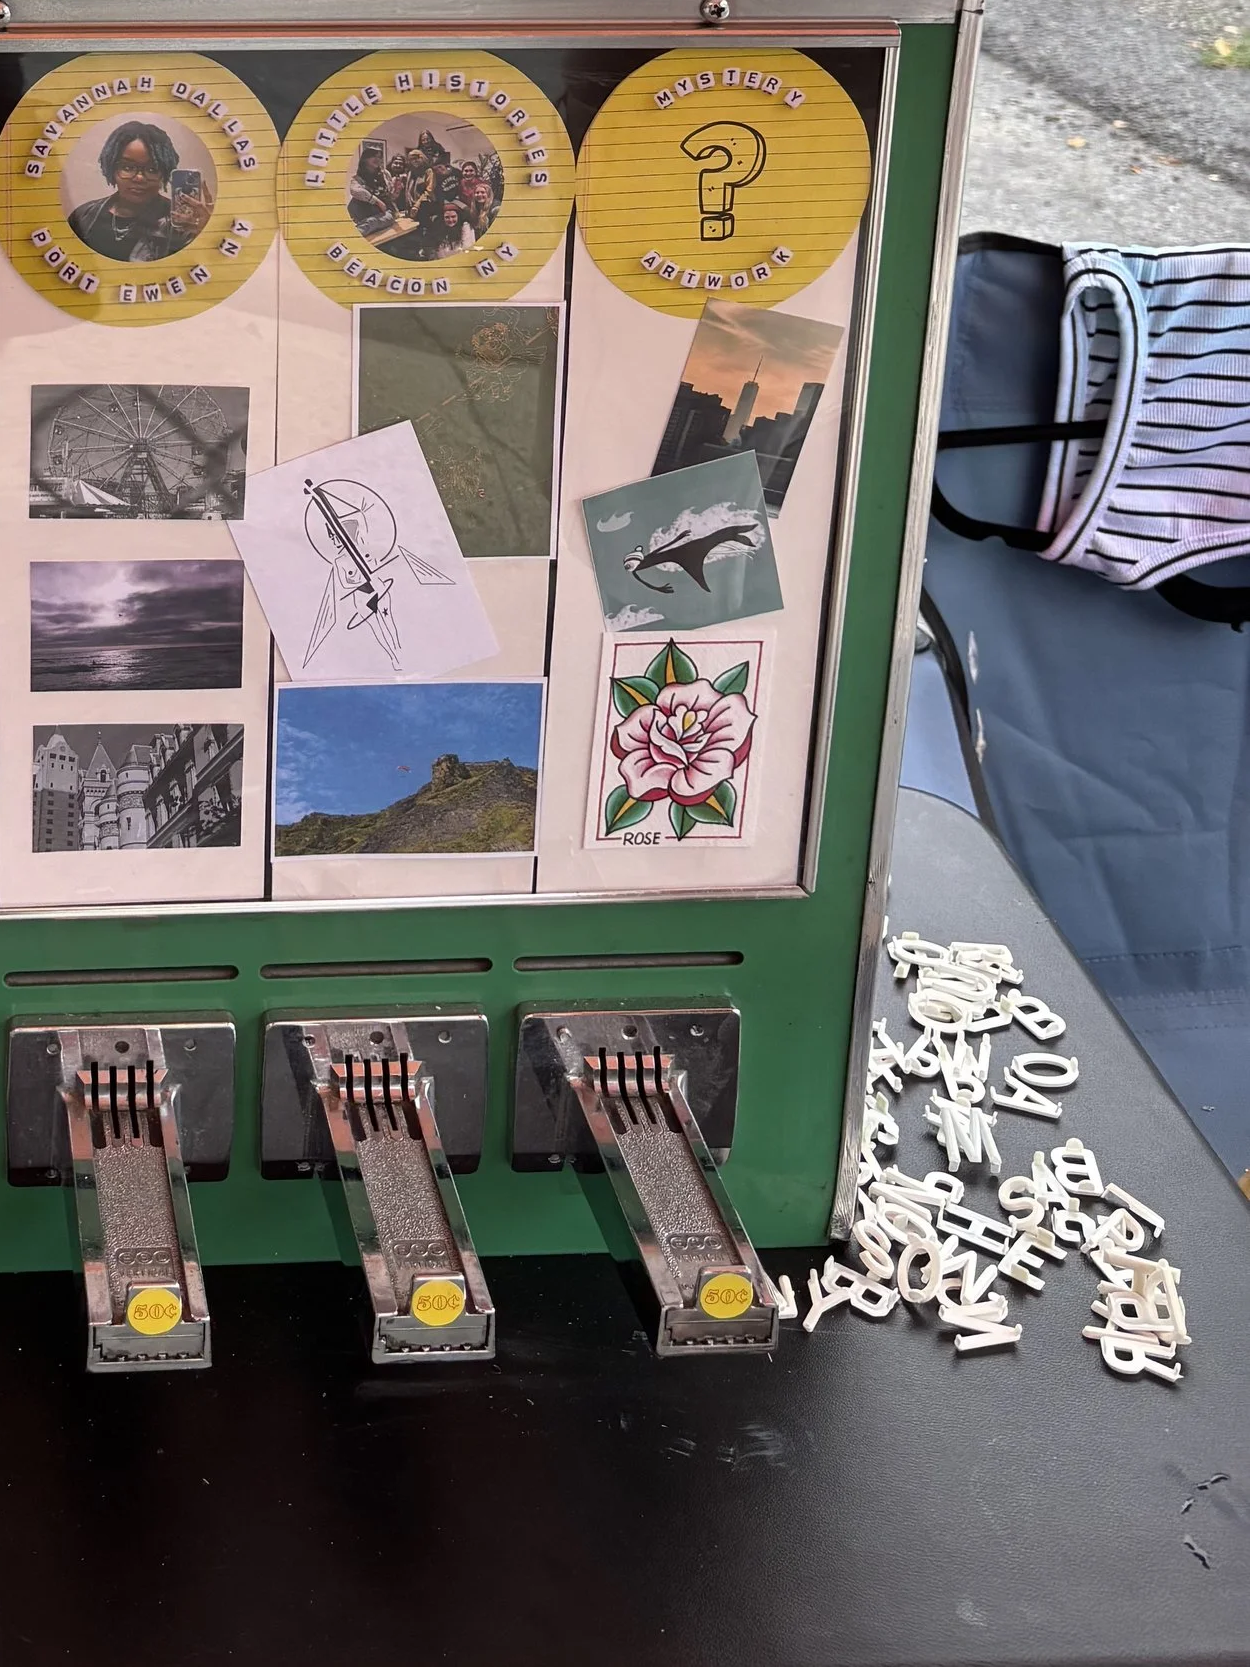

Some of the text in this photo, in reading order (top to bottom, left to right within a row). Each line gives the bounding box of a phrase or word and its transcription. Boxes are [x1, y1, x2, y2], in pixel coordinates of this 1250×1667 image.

[658, 71, 801, 107] MYSTERY
[27, 77, 256, 175] SAVANNAH DALLAS
[307, 74, 548, 184] LITTLE HISTORIES
[34, 222, 248, 301] PORT EWEN NY
[329, 245, 515, 292] BEACON NY
[645, 250, 791, 288] ARTWORK
[622, 831, 661, 846] ROSE
[134, 1304, 177, 1320] 50¢
[417, 1294, 460, 1311] 50¢
[705, 1289, 748, 1304] 50¢
